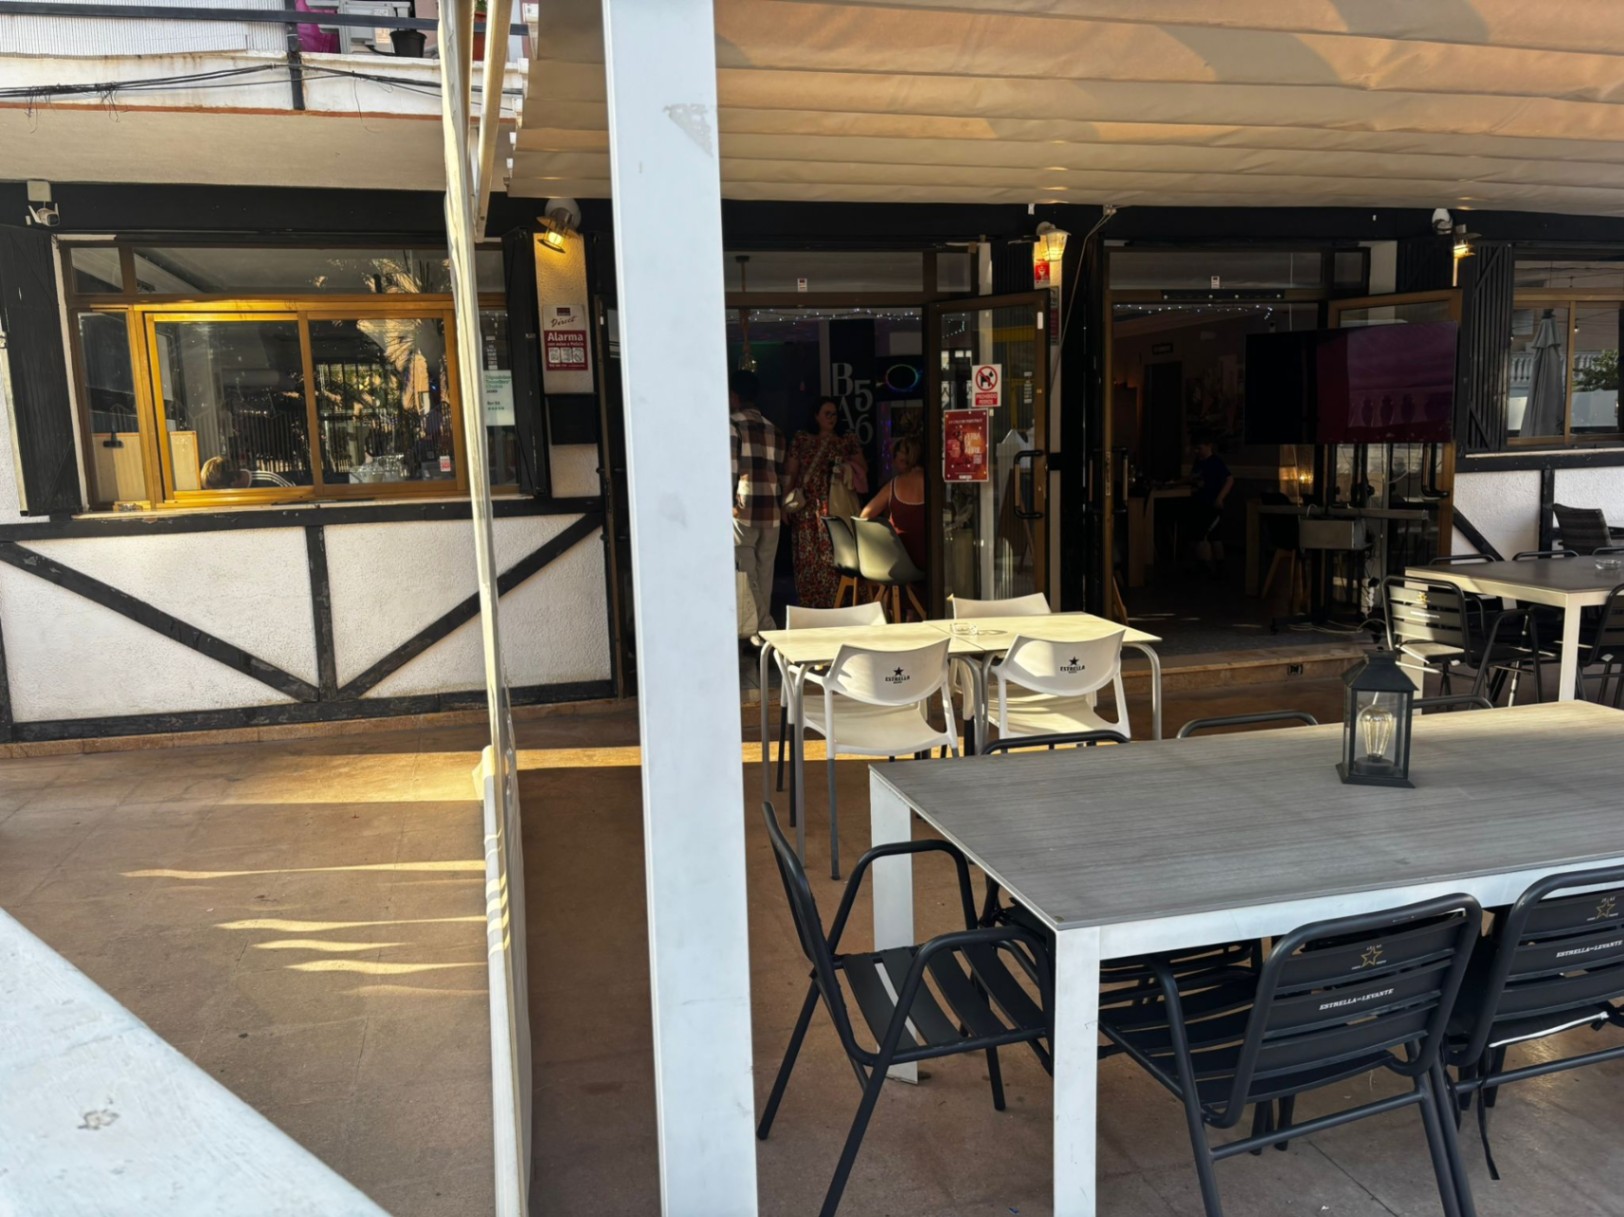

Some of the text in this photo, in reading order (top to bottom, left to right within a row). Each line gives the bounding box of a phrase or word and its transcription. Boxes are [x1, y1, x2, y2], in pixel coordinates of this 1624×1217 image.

[547, 331, 584, 341] Alarma
[1555, 940, 1623, 958] ESTRELLA LEVANTE
[1319, 988, 1394, 1011] ESTRELLA LEVANTE
